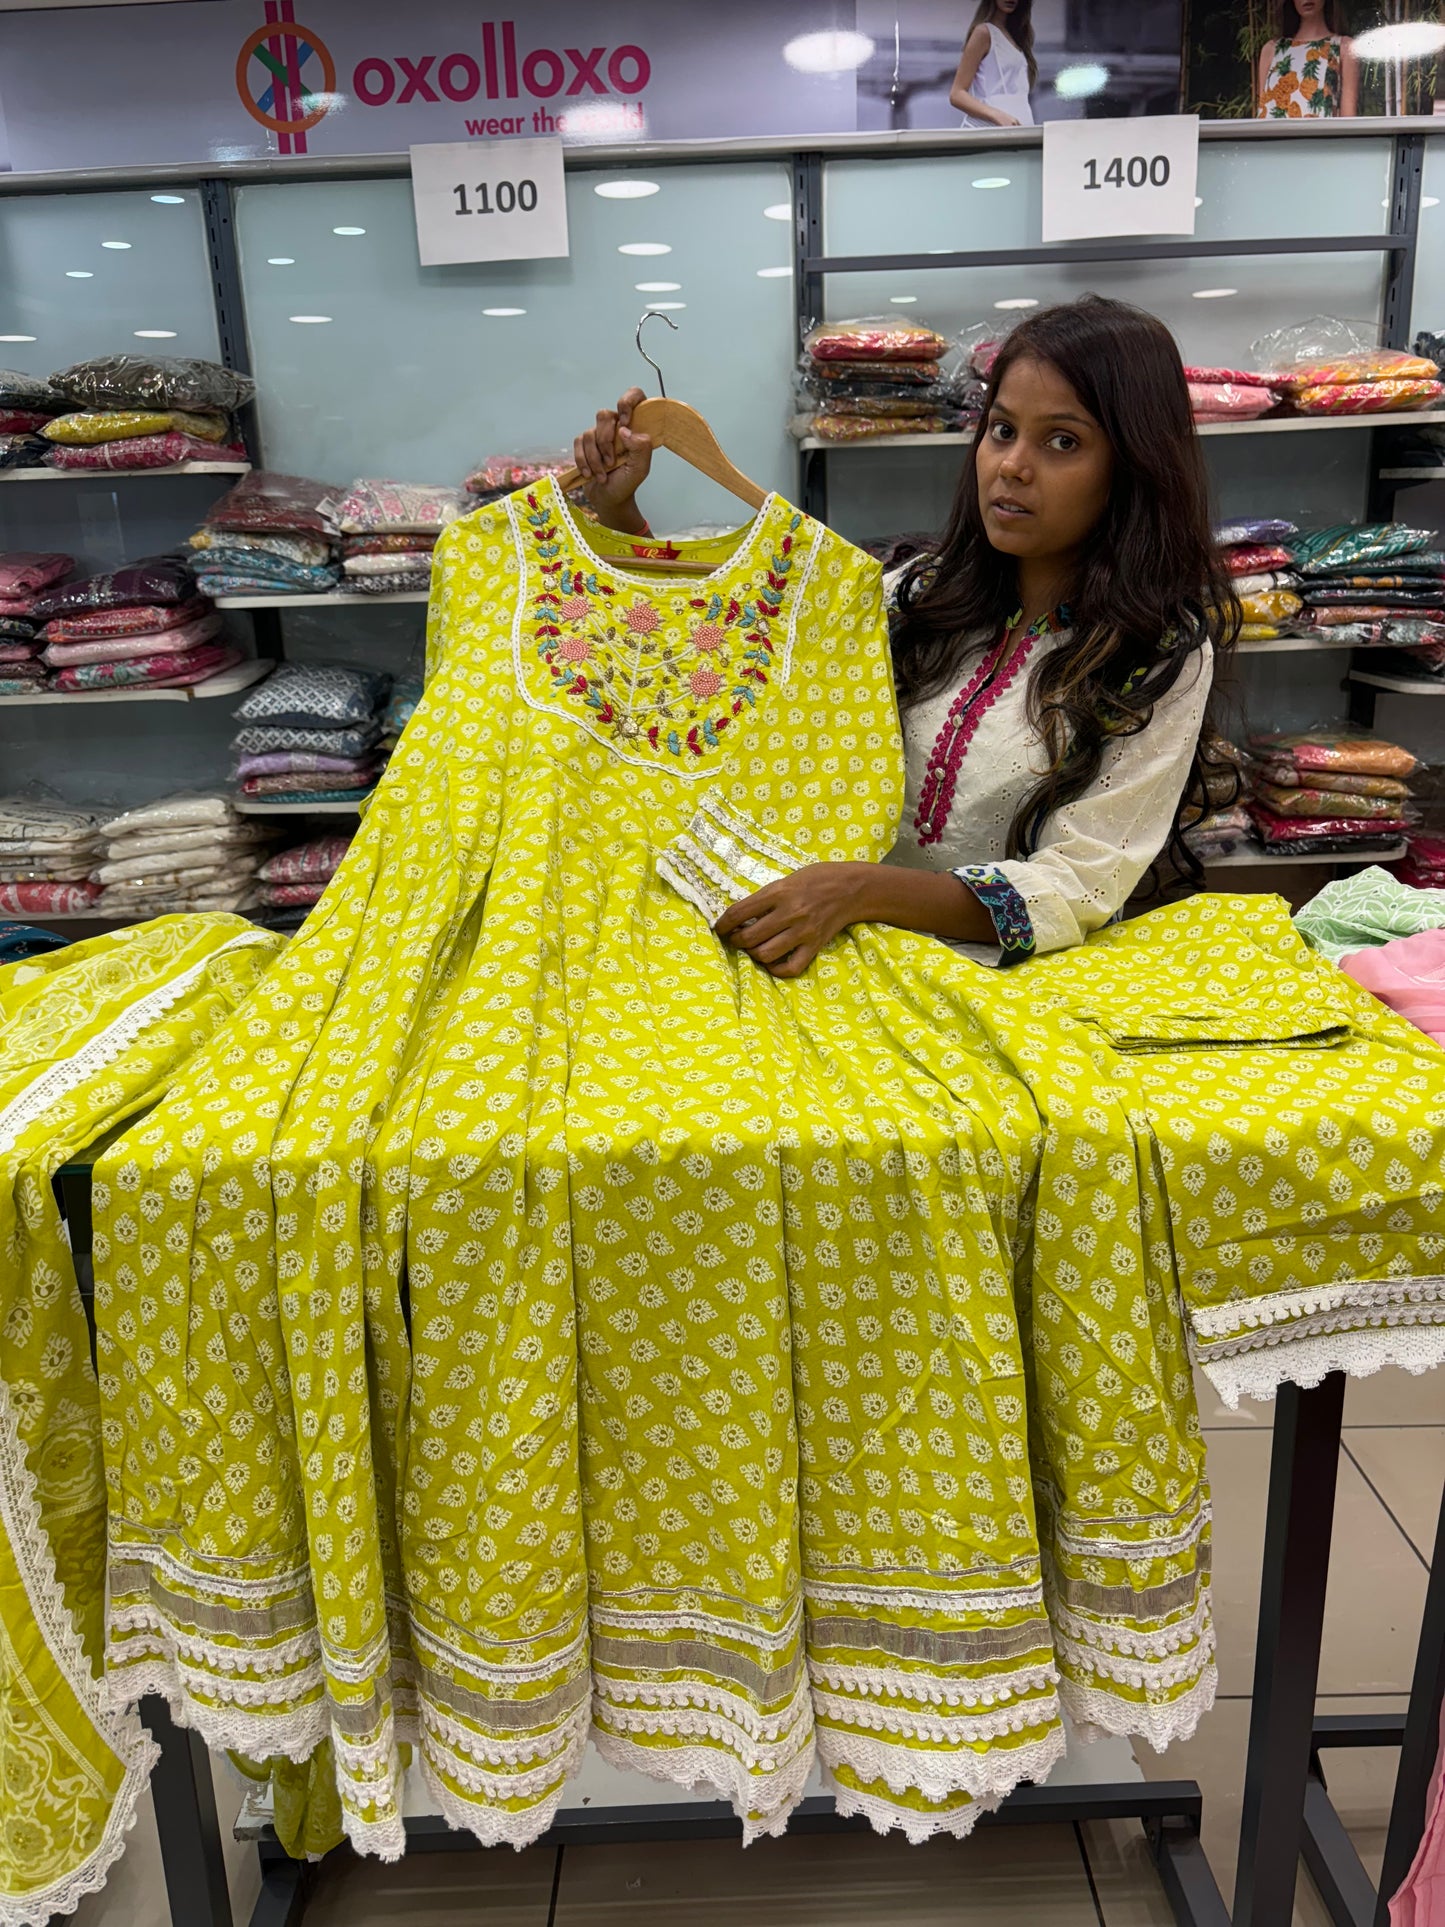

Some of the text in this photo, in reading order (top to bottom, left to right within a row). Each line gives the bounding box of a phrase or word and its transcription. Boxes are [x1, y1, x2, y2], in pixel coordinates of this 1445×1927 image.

[353, 21, 651, 106] oxolloxo
[464, 116, 525, 136] wear
[532, 106, 567, 133] the
[1083, 155, 1170, 190] 1400
[453, 180, 538, 216] 1100
